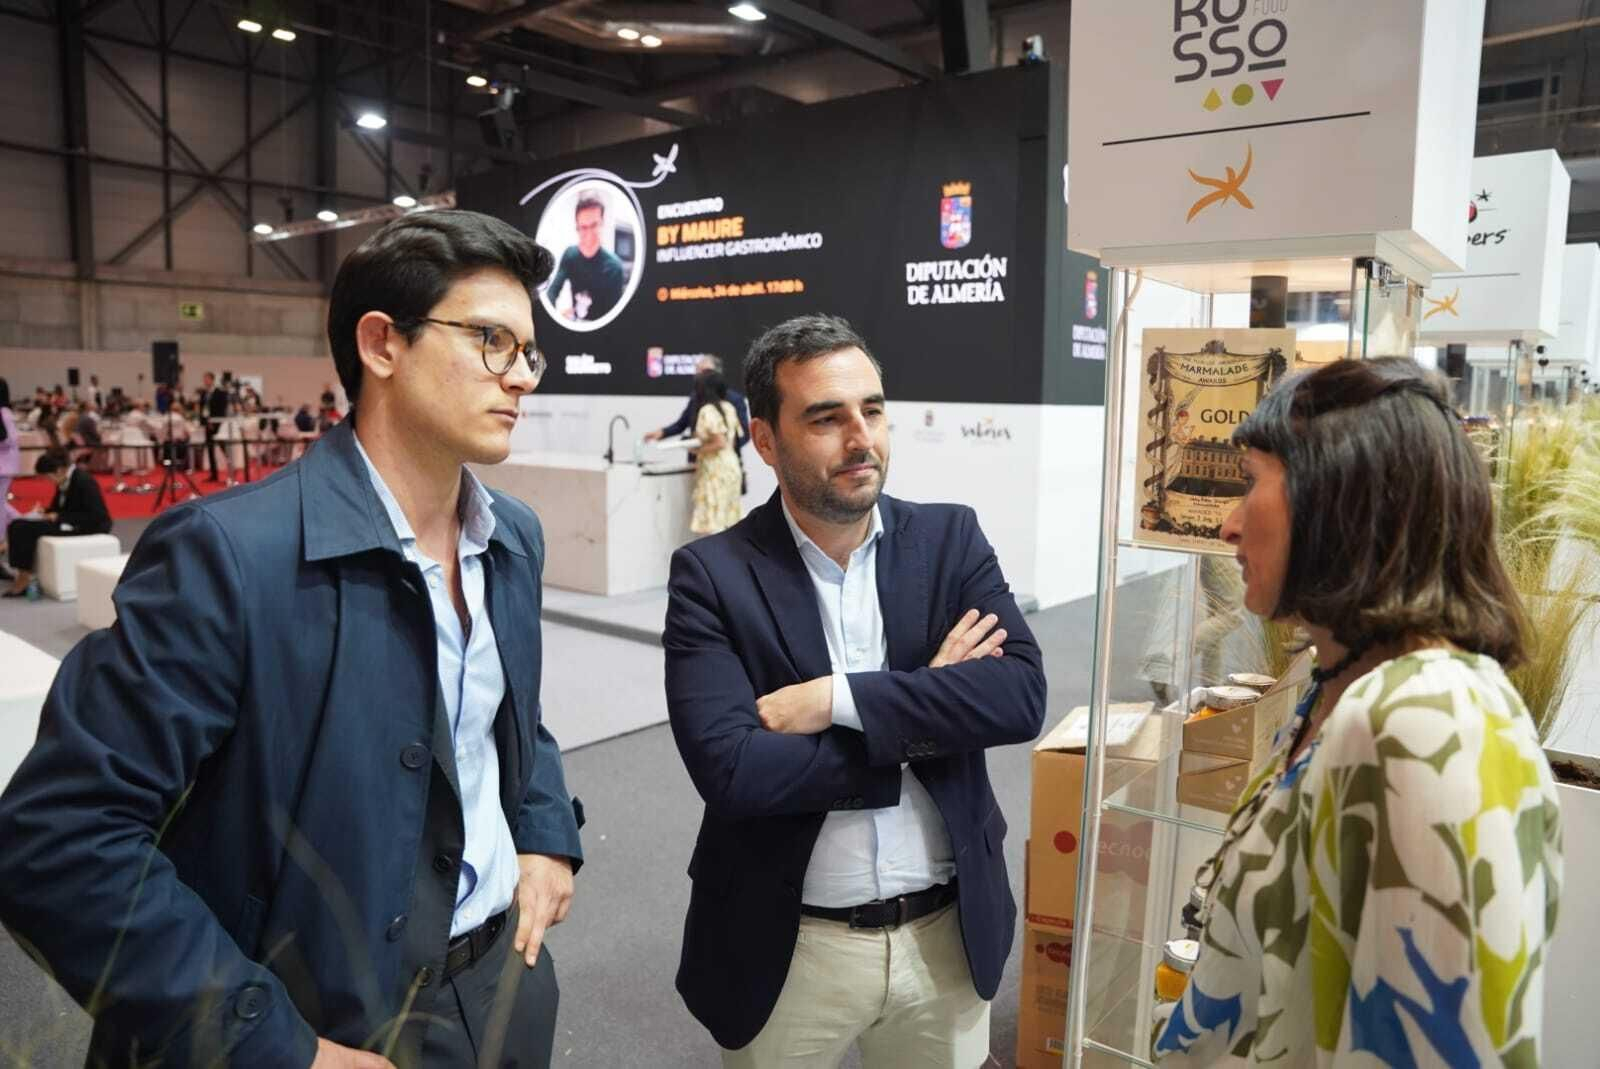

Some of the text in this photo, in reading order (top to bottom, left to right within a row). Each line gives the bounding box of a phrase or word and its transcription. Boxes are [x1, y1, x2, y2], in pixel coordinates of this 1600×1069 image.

[1173, 18, 1288, 83] SSO
[657, 216, 744, 246] BY MAURE
[1467, 228, 1510, 246] ers
[656, 231, 823, 263] INFLUENCER GASTRONÓMICO
[906, 253, 1008, 283] DIPUTACIÓN
[907, 278, 1005, 305] DE ALMERÍA
[1180, 363, 1249, 376] MARMALADE
